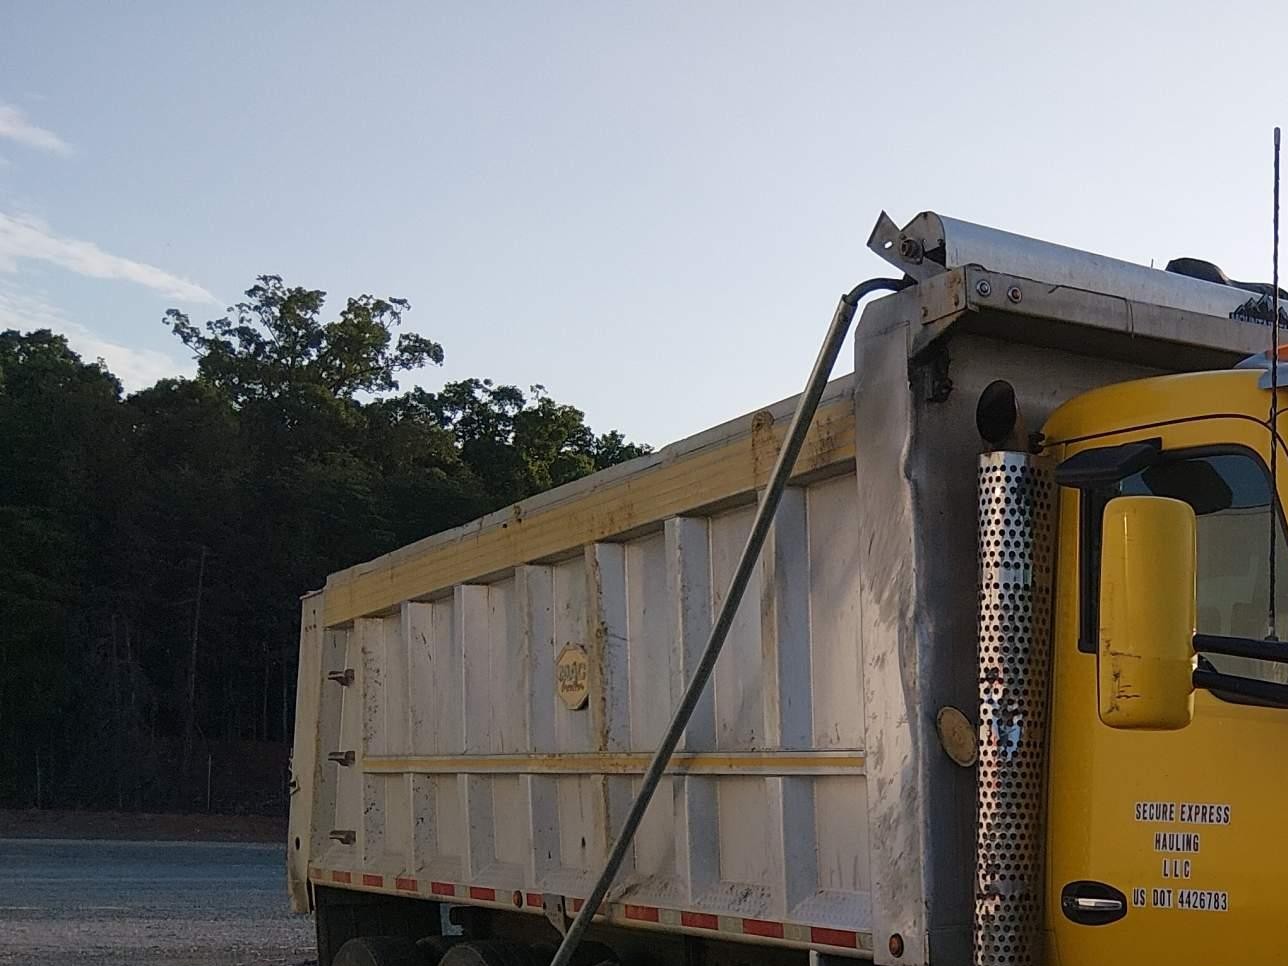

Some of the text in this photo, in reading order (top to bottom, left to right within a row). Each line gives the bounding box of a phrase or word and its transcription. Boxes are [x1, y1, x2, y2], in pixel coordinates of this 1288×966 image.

[1135, 803, 1230, 824] SECURE EXPRESS
[1154, 833, 1199, 852] HAULING
[1133, 888, 1228, 911] US DOT 4426783
